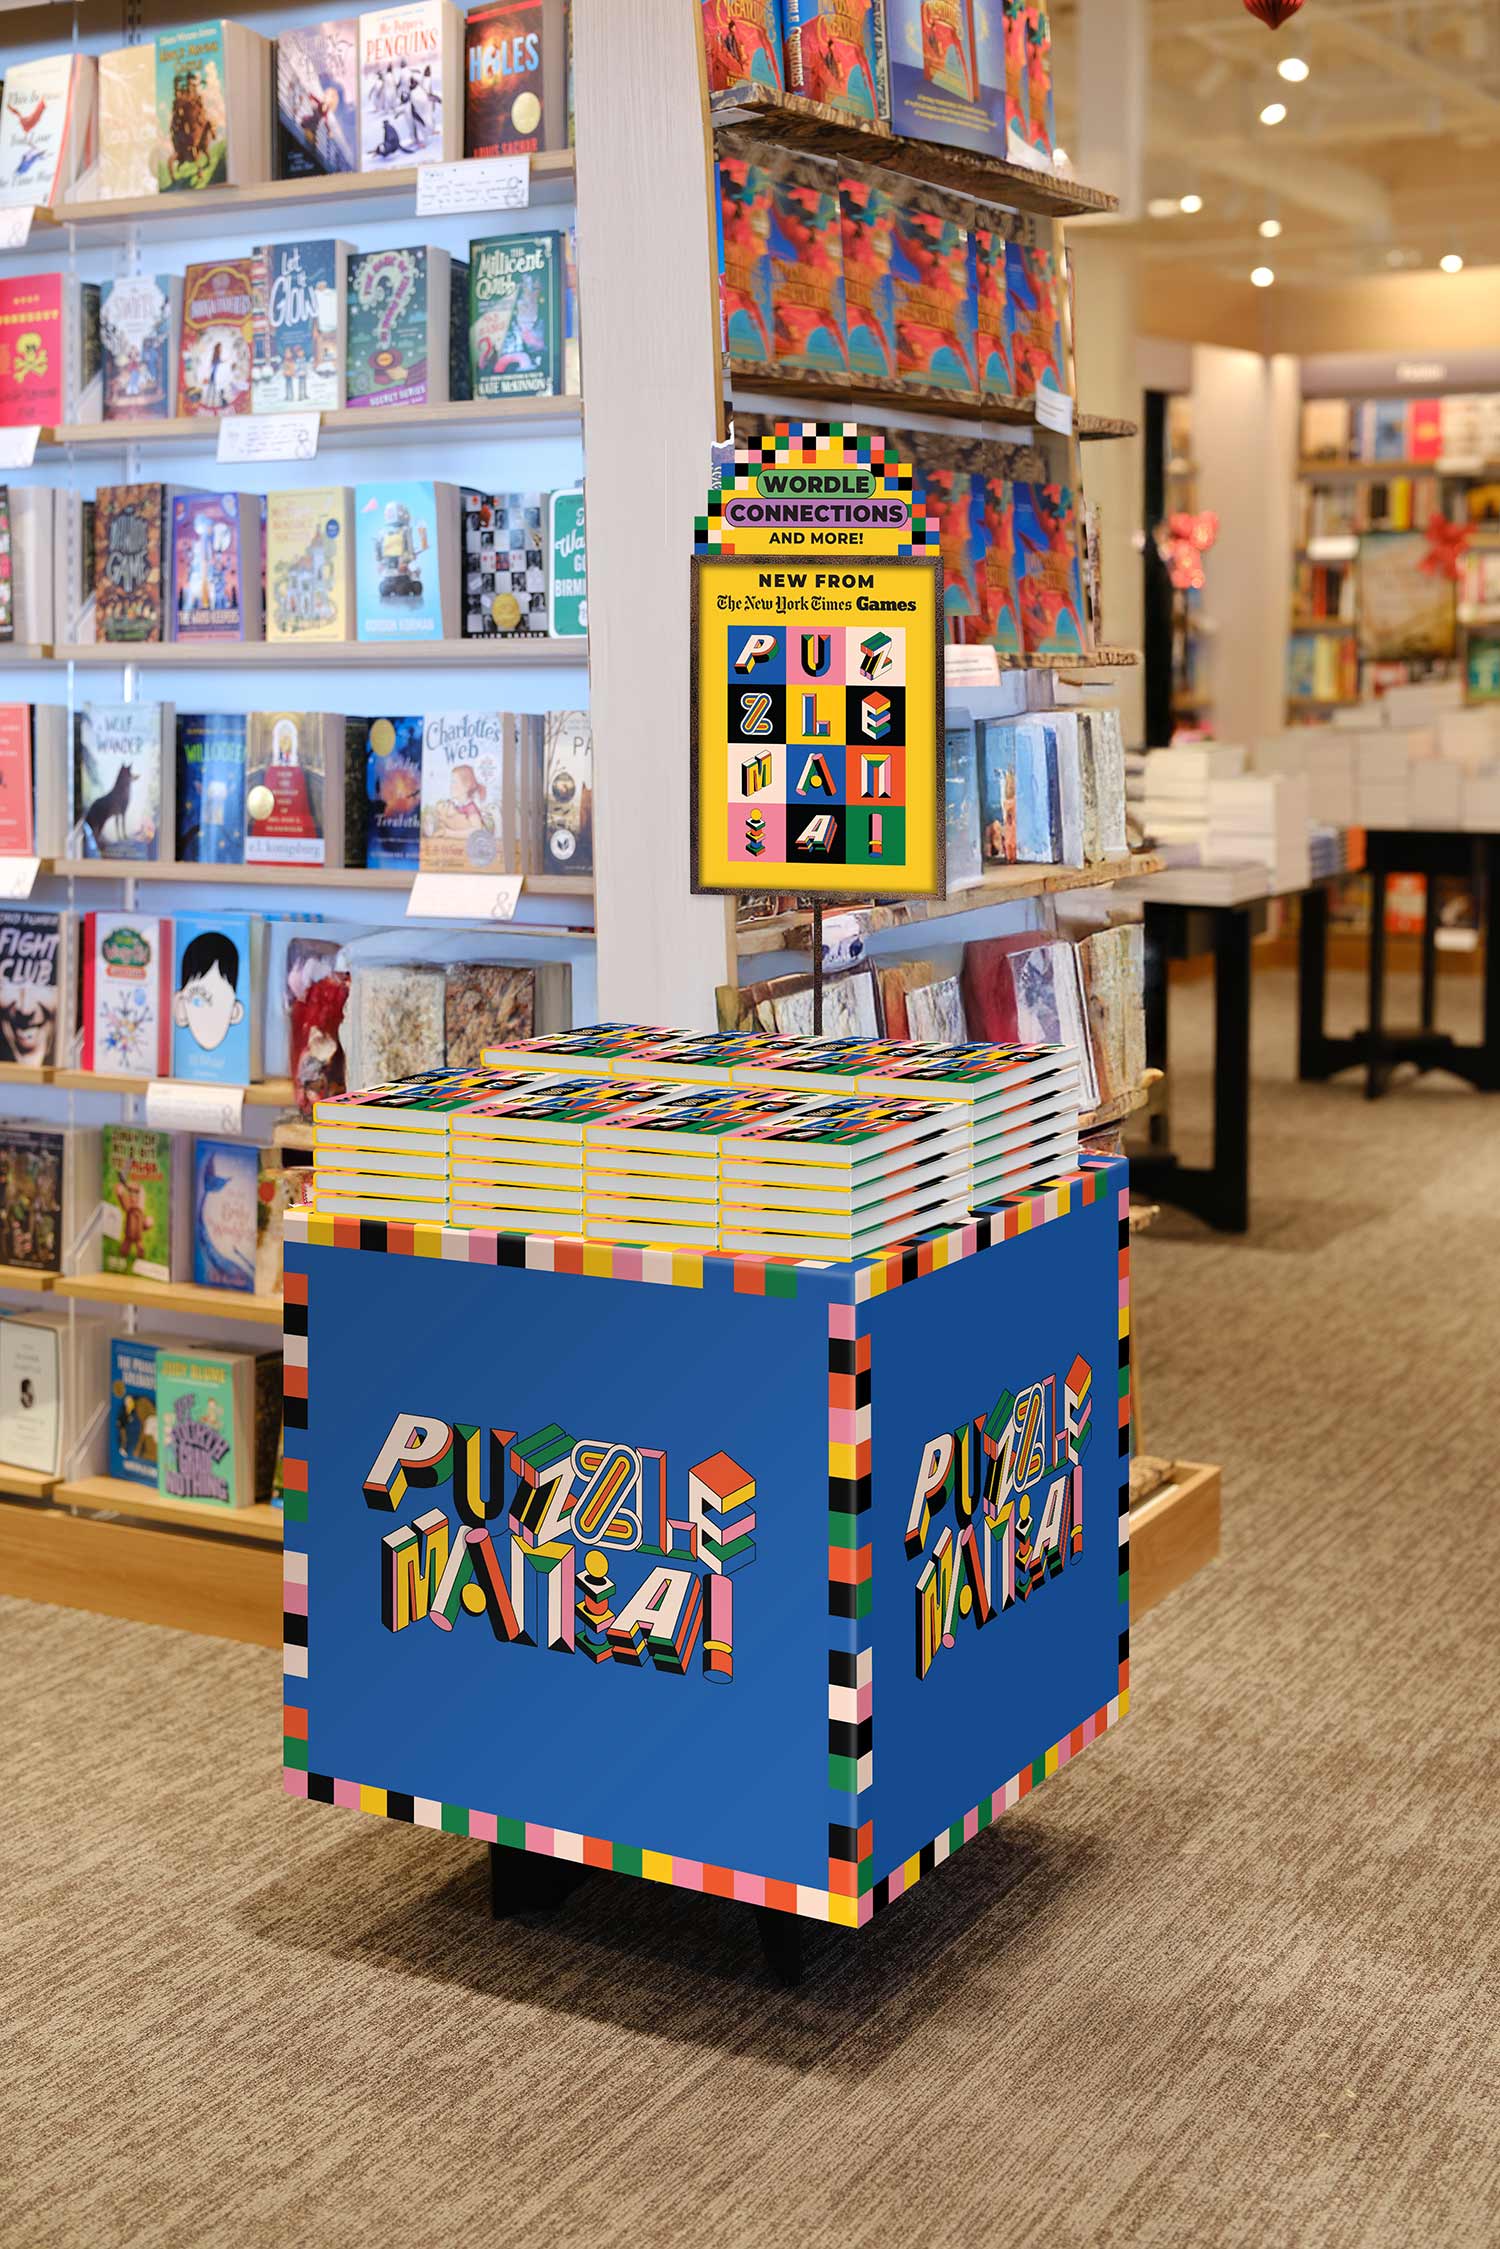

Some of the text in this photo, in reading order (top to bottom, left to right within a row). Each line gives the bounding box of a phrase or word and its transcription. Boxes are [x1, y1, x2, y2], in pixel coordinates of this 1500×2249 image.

[366, 28, 438, 63] PENGUINS
[469, 33, 540, 82] HOLES
[281, 247, 302, 275] Let
[478, 248, 545, 279] Millicent
[269, 274, 319, 327] Glow
[764, 476, 869, 493] WORDLE
[730, 505, 903, 523] CONNECTIONS
[769, 533, 863, 544] AND MORE!
[759, 574, 874, 588] NEW FROM
[717, 595, 917, 613] The New York Times Games
[426, 714, 502, 751] Charlotte's
[444, 738, 480, 763] Web
[0, 927, 60, 961] FIGHT
[0, 958, 53, 985] CLUB
[904, 1352, 1093, 1561] PUZZLE
[362, 1411, 757, 1577] PUZZLE
